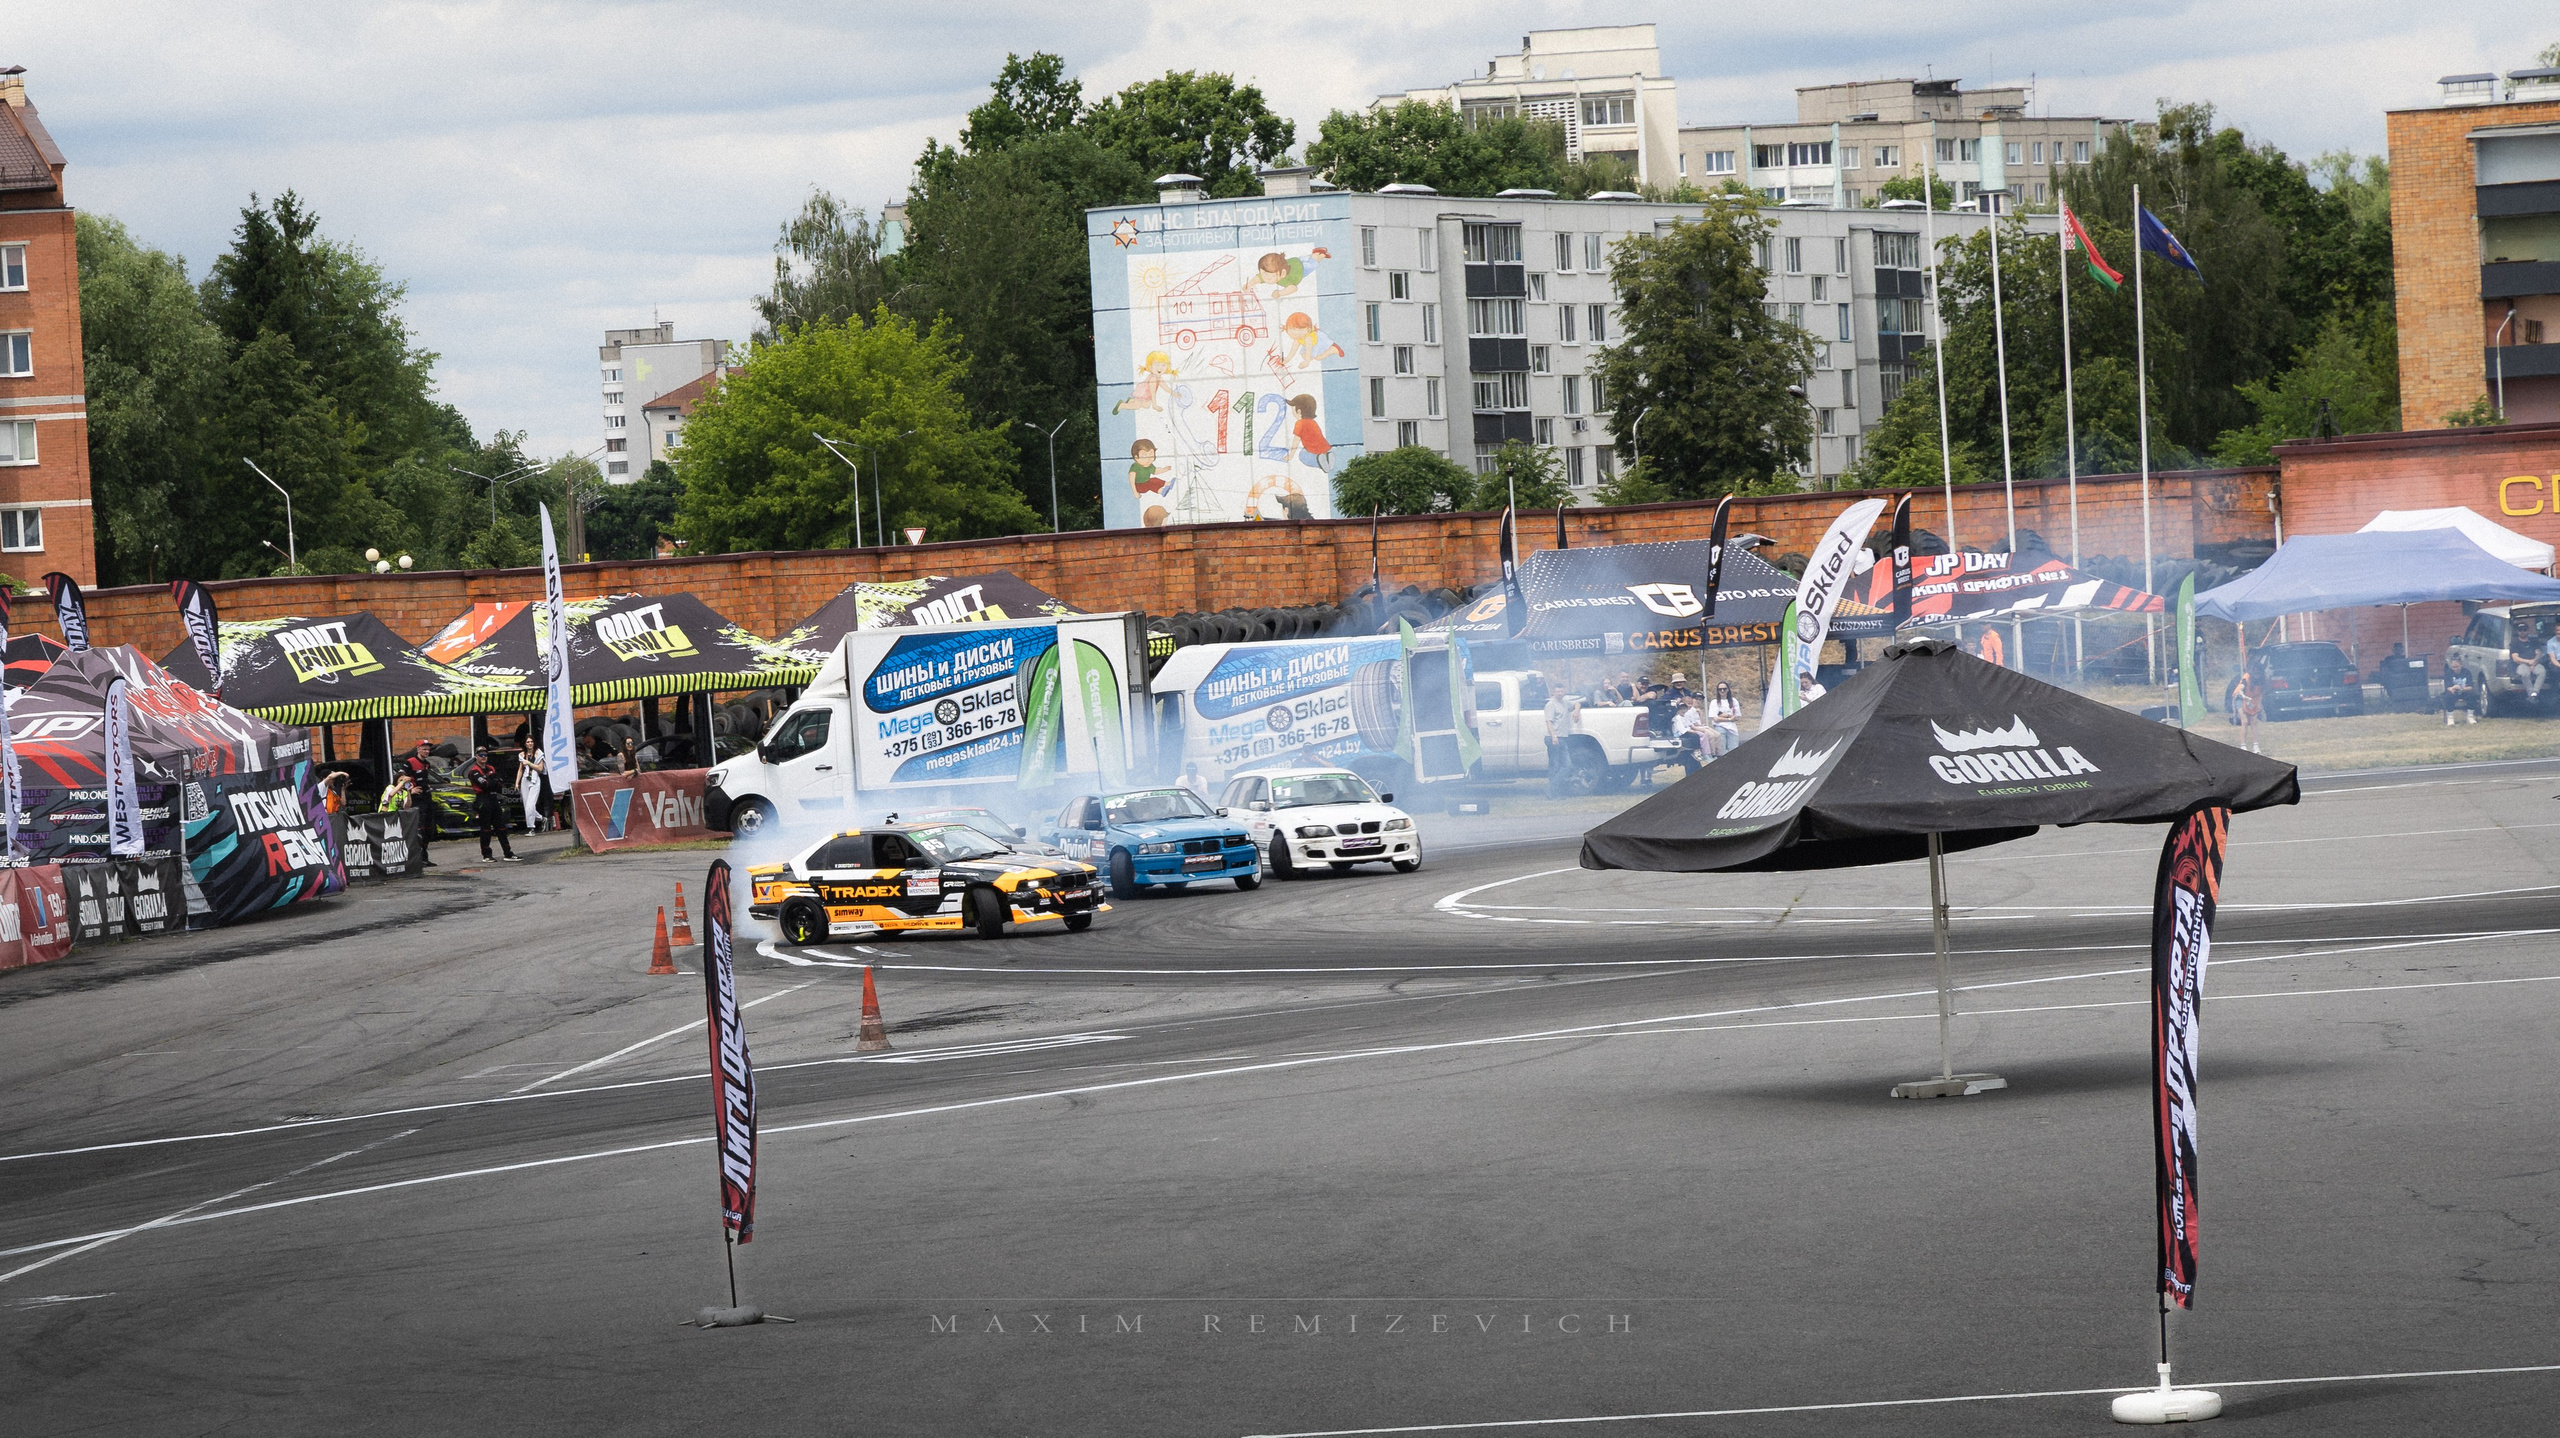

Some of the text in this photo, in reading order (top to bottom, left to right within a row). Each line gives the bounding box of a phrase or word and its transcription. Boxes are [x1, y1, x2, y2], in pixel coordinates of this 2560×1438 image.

[1143, 203, 1322, 230] МЧС БЛАГОДАРИТ
[1145, 223, 1324, 248] ЗАБОТЛИВЫХ РОДИТЕЛЕЙ
[1173, 301, 1193, 315] 101
[1207, 390, 1290, 461] 112
[1805, 531, 1853, 615] Sklad
[1925, 552, 2010, 576] JP DAY
[1750, 587, 1771, 598] ИЗ
[1963, 574, 2033, 592] ДРИФТА
[2038, 571, 2069, 582] №1
[1533, 595, 1637, 612] CARUS BREST
[1628, 622, 1781, 651] CARUS BREST
[877, 638, 1014, 695] ШИНЫ и ДИСКИ
[899, 658, 1014, 702] ЛЕГКОВЫЕ И ГРУЗОВЫЕ
[1208, 644, 1349, 700] ШИНЫ и ДИСКИ
[1231, 684, 1285, 708] ЛЕГКОВЫЕ
[1296, 665, 1349, 691] ГРУЗОВЫЕ
[878, 683, 1015, 740] Mega Sklad
[1209, 691, 1349, 746] Mega Sklad
[884, 739, 918, 758] +375
[946, 708, 1016, 741] 366-16-78
[1214, 744, 1250, 765] +375
[1278, 716, 1350, 749] 366-16-78
[111, 694, 132, 846] WESTMOTORS
[1929, 745, 2101, 785] GORILLA
[1273, 786, 1291, 797] 11
[1976, 780, 2093, 797] ENERGY DRINK
[228, 785, 306, 835] MOSHIM
[1105, 797, 1127, 810] 42
[69, 834, 110, 844] MND.ONE
[380, 840, 409, 865] GORILLA
[920, 838, 946, 850] 85
[344, 843, 373, 867] GORILLA
[133, 892, 168, 920] GORILLA
[831, 885, 901, 899] TRADEX
[834, 908, 864, 917] simway
[2181, 892, 2205, 1039] СОРЕВНОВАНИЯ
[2165, 886, 2197, 1101] ДРИФТА
[712, 916, 752, 1194] ЛИГА ДРИФТА
